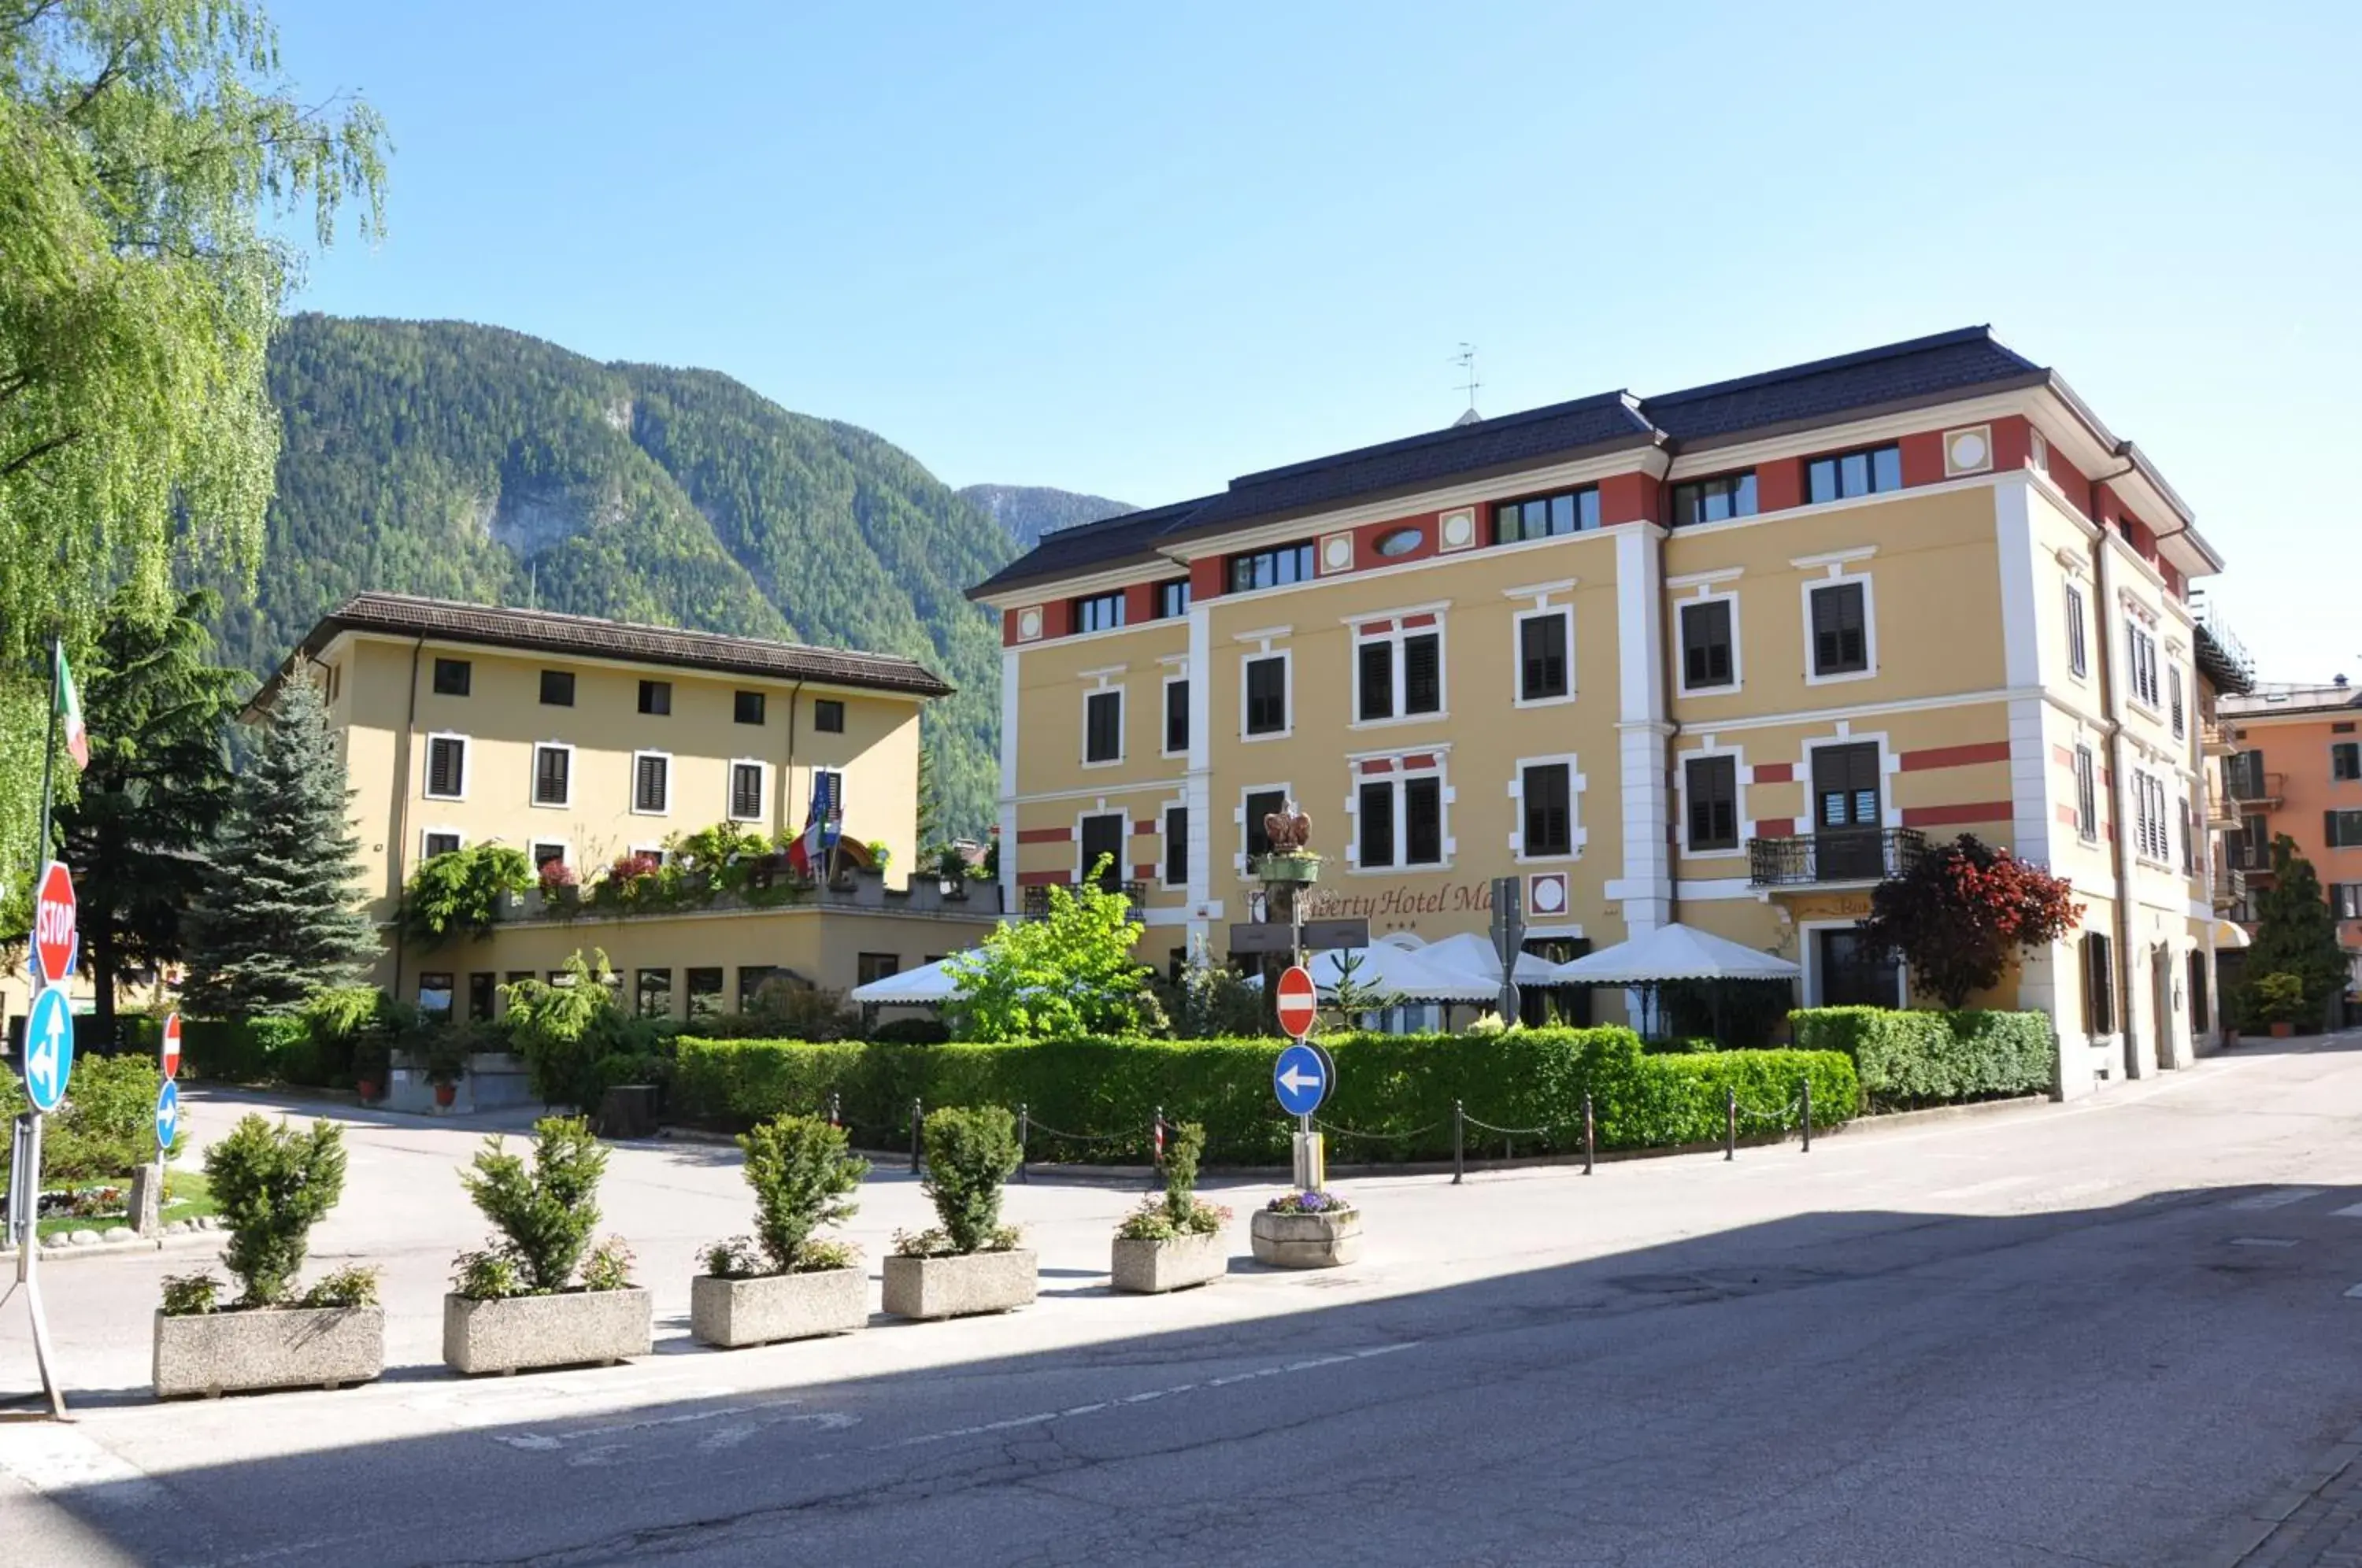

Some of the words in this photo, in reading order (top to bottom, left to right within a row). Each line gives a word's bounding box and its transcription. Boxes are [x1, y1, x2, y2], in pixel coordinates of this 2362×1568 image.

[1309, 893, 1377, 919] iberty
[1379, 882, 1451, 915] Hotel
[1453, 881, 1493, 912] Ma
[40, 900, 73, 945] STOP
